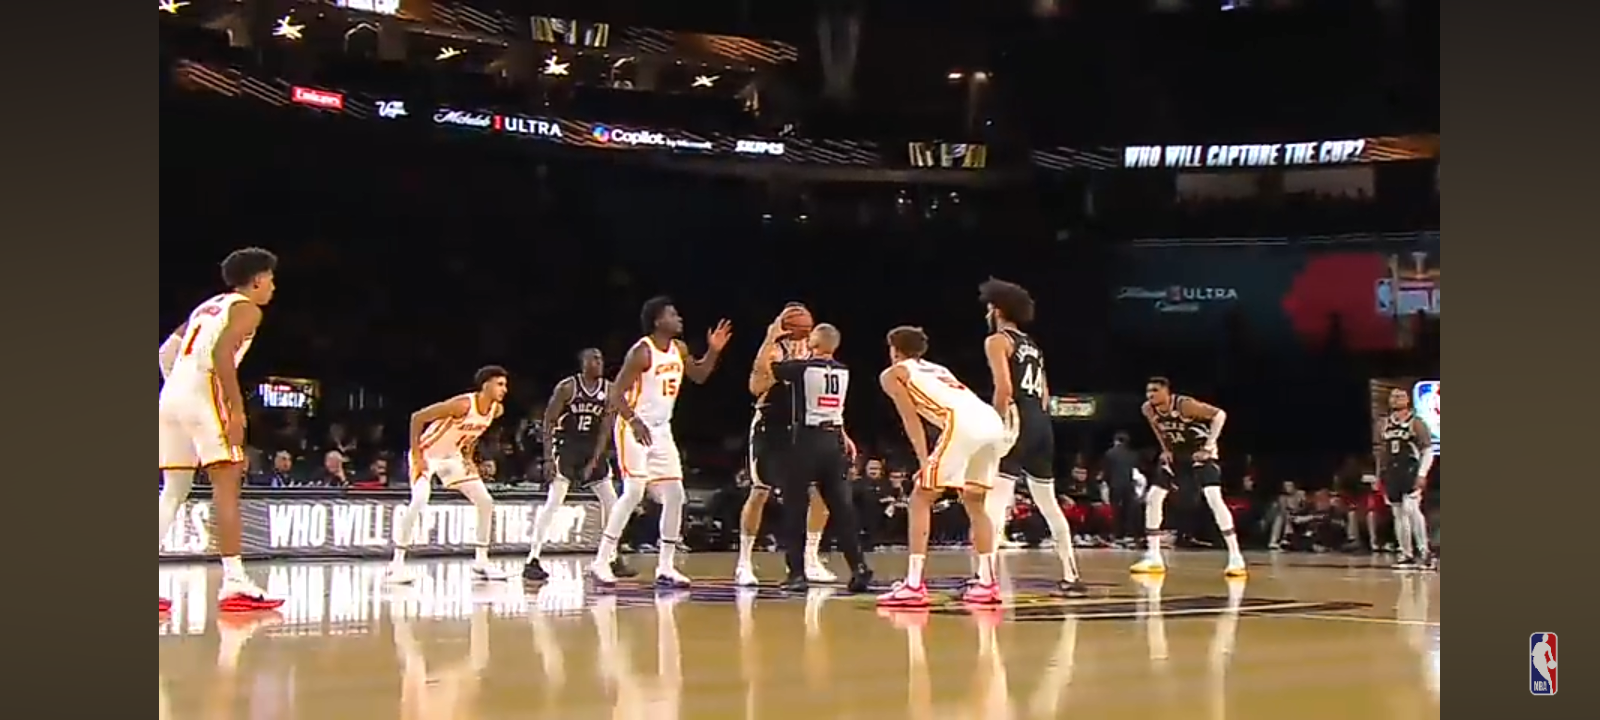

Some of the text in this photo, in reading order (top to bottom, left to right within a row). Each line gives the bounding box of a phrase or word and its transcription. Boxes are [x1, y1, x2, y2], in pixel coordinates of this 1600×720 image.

[504, 115, 563, 137] ULTRA
[611, 128, 666, 146] Copilot
[1124, 139, 1366, 168] WHO WILL CAPTURE THE CUP?
[184, 324, 202, 356] 1
[662, 378, 677, 397] 15
[824, 373, 840, 396] 10
[1020, 362, 1043, 398] 44
[577, 414, 592, 431] 12
[269, 503, 328, 549] WHO
[332, 503, 389, 548] WILL
[493, 504, 533, 545] THE
